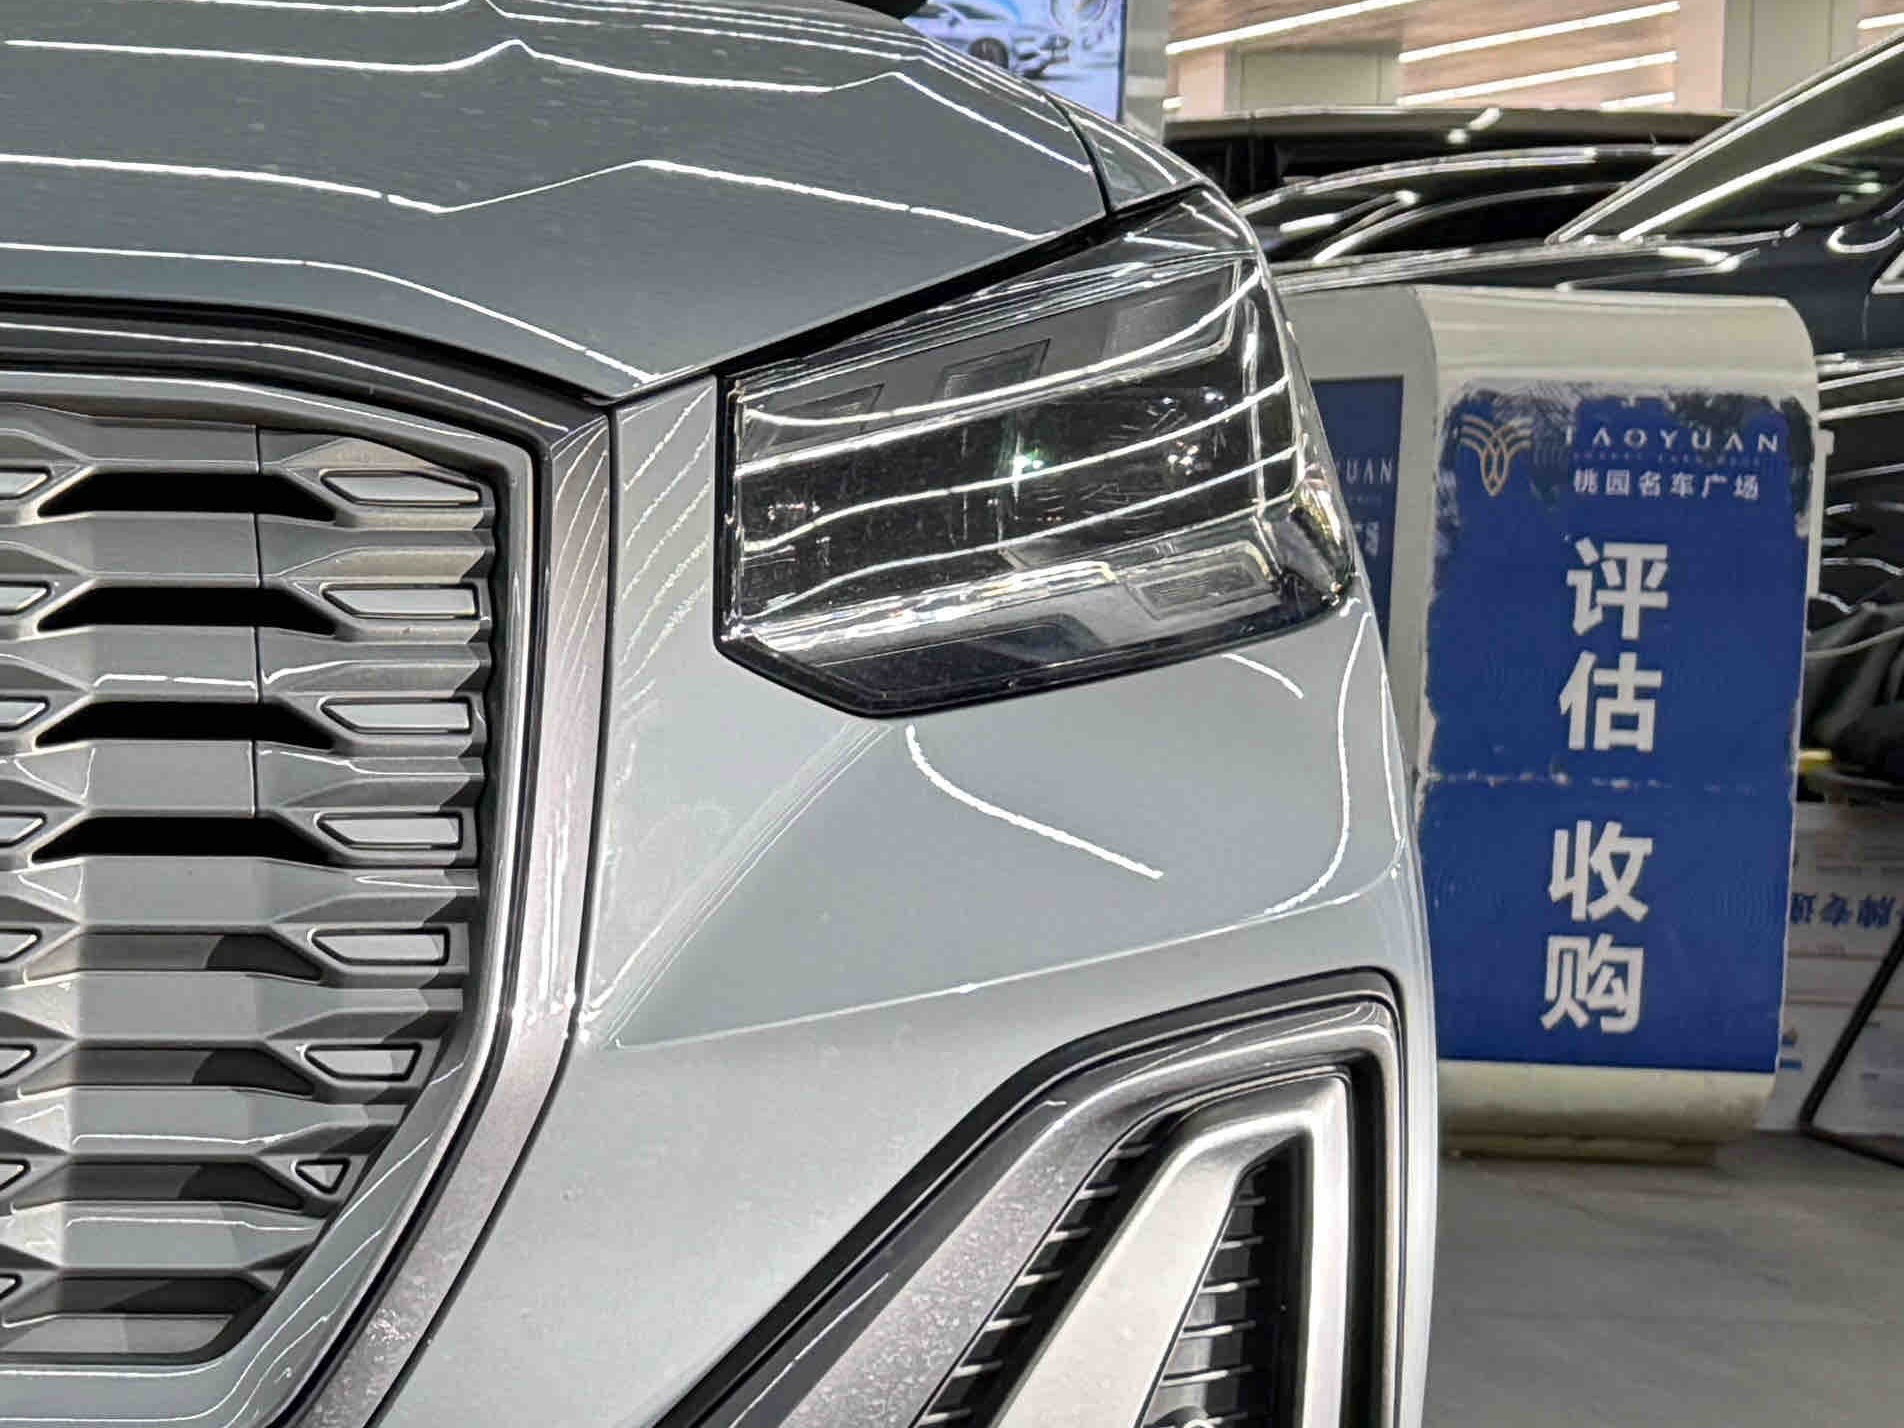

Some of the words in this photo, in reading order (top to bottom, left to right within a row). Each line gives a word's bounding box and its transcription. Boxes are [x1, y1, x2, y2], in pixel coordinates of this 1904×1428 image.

[1564, 425, 1778, 452] TAOYUAN
[1573, 469, 1760, 500] 桃园名车广场
[1558, 536, 1669, 754] 评估
[1540, 819, 1655, 1035] 收购
